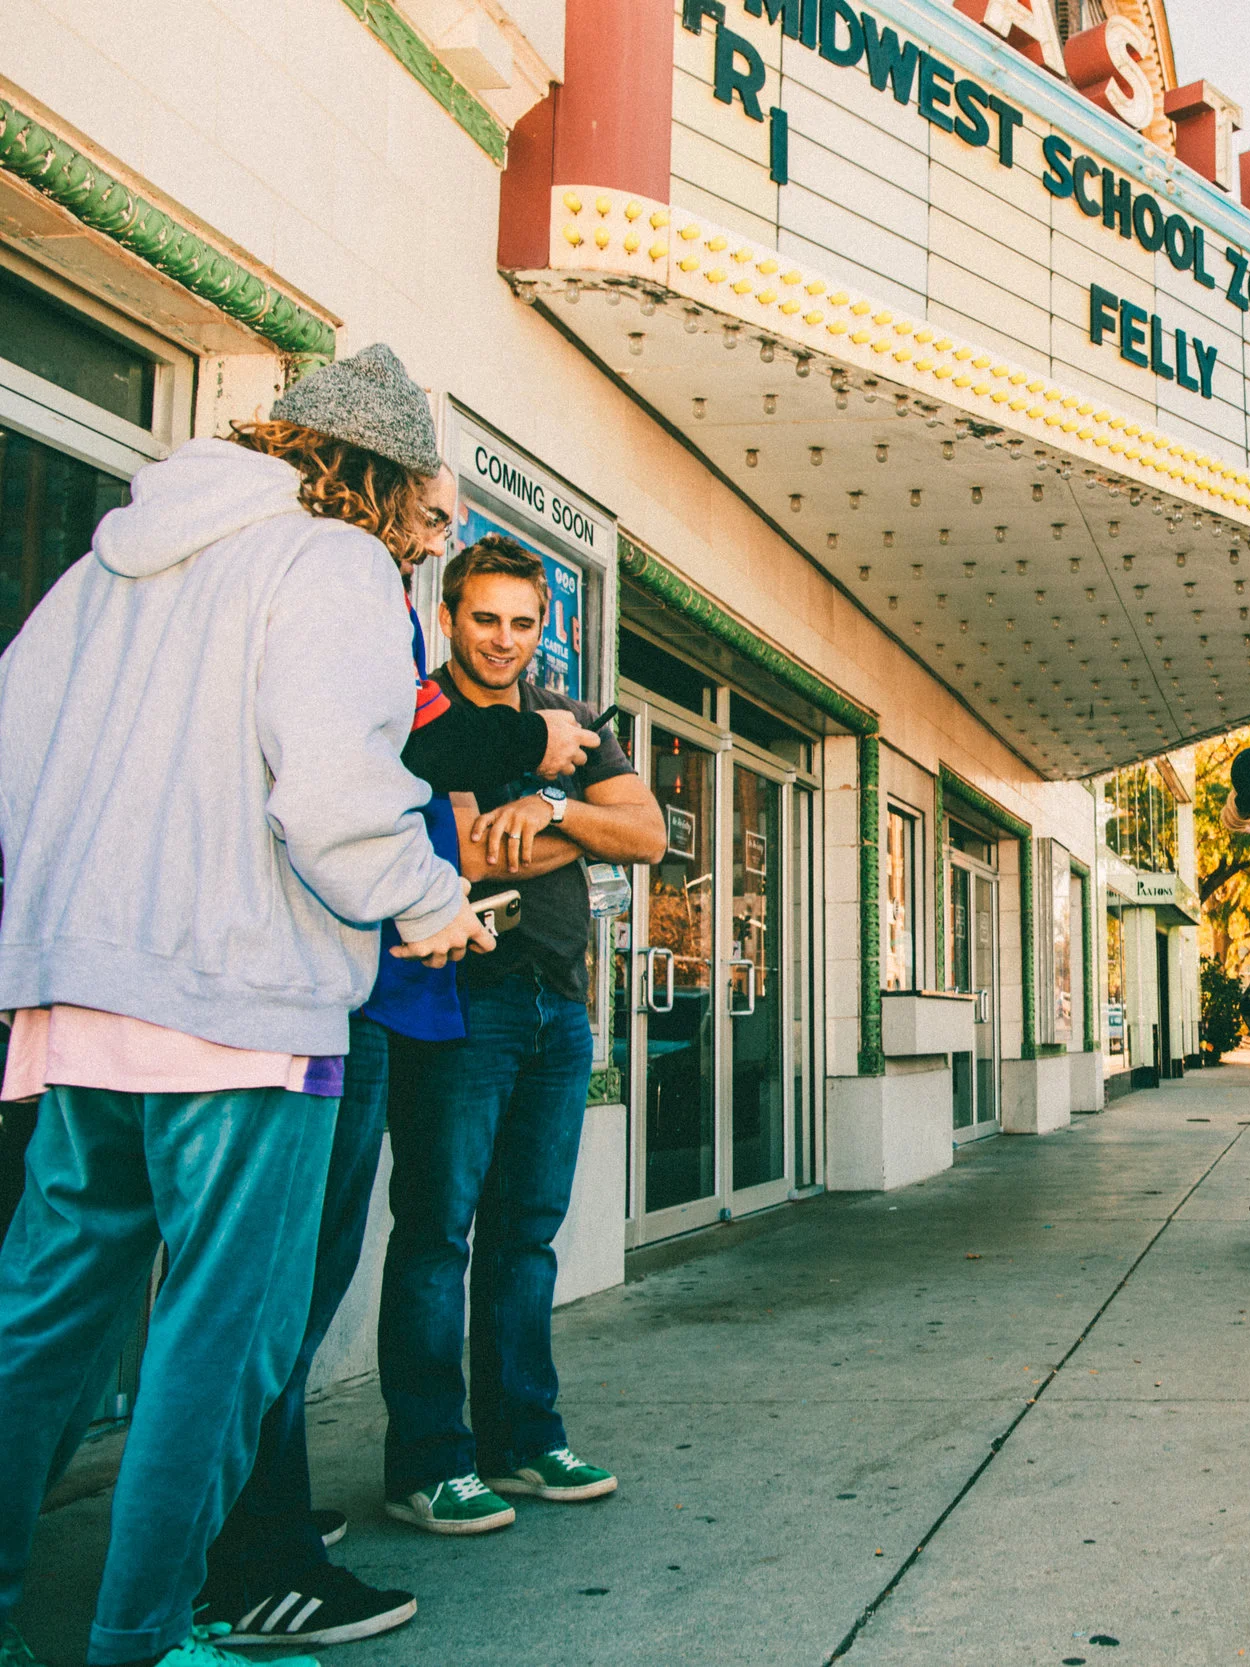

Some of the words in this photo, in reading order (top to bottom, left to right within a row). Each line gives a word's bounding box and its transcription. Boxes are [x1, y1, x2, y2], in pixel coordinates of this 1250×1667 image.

[1043, 134, 1215, 289] SCHOOL
[1090, 283, 1218, 400] FELLY
[475, 446, 545, 514] COMING
[551, 497, 594, 546] SOON
